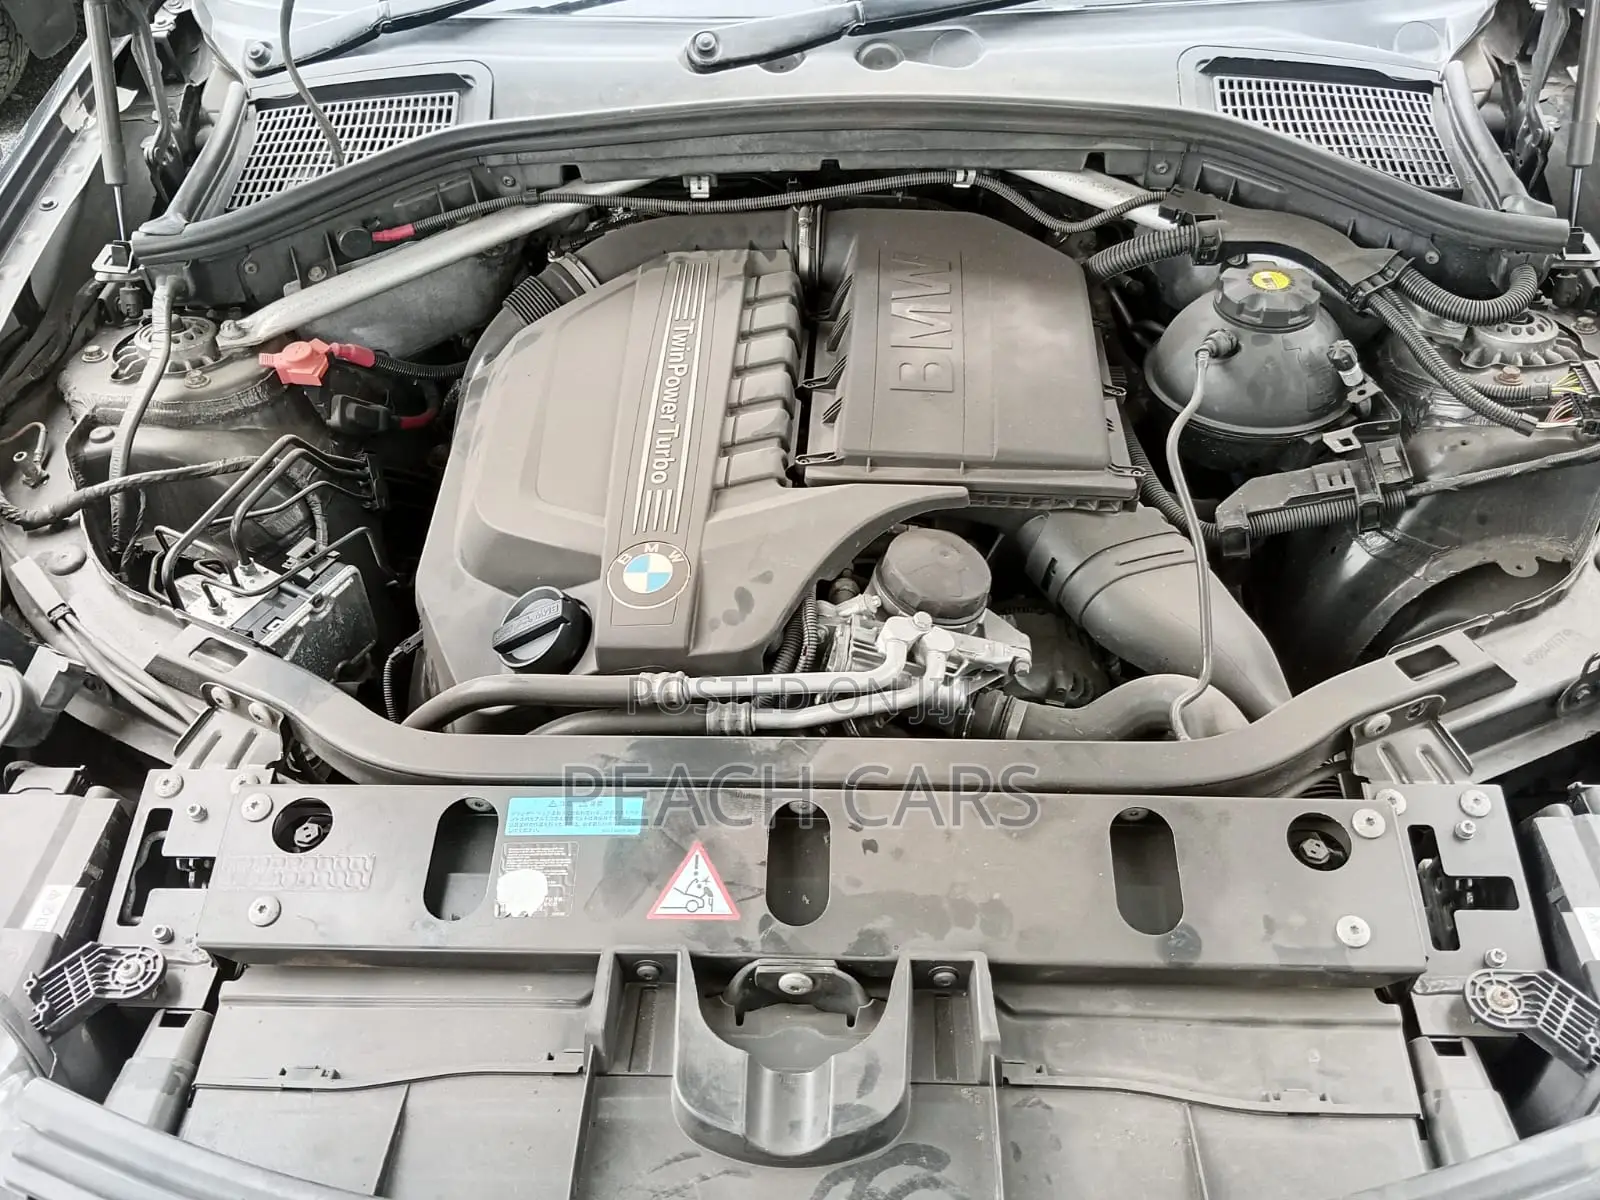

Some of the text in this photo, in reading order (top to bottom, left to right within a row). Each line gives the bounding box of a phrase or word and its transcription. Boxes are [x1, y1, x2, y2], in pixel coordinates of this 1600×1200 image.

[890, 253, 954, 392] BMW
[650, 321, 694, 484] TwinPower Turbo
[617, 543, 685, 565] BMW
